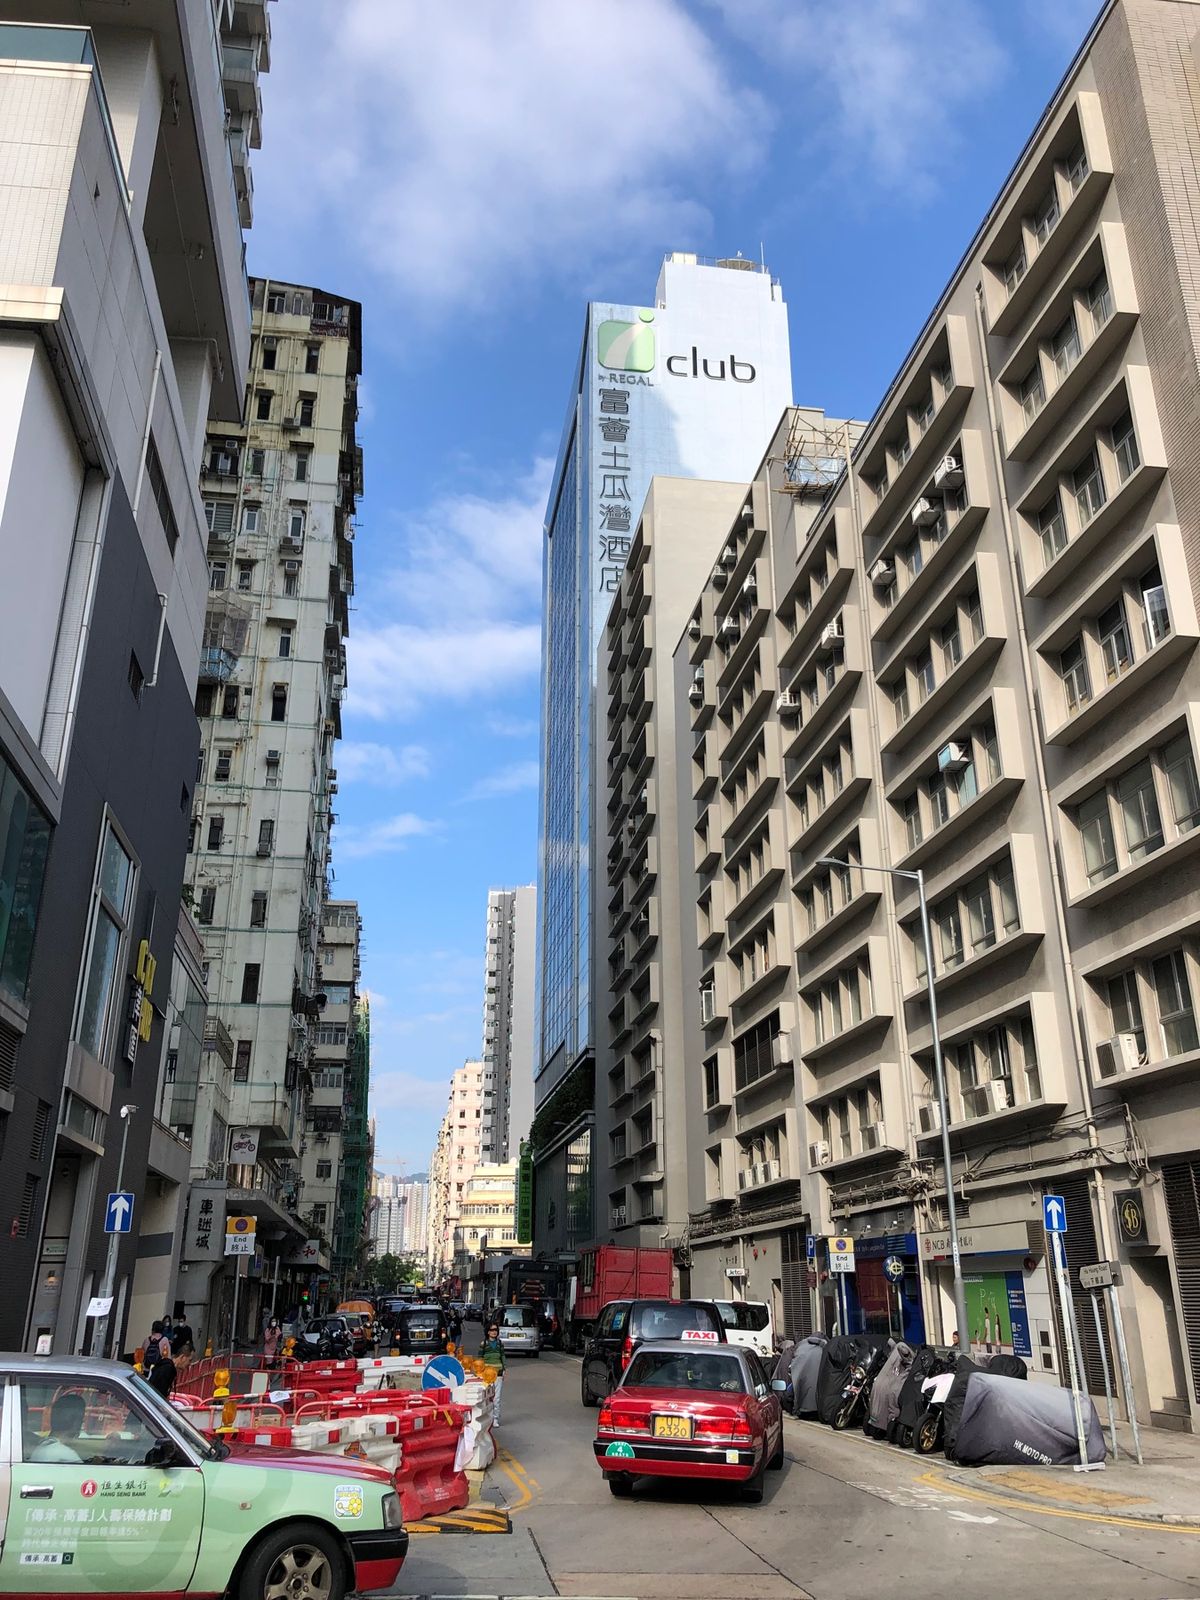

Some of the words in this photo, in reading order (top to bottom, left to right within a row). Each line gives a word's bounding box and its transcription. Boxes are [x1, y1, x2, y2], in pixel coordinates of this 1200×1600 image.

[666, 346, 757, 384] club
[609, 373, 654, 387] REGAL
[599, 387, 631, 593] 富薈土瓜灣酒店
[231, 1244, 249, 1252] 終止
[932, 1239, 945, 1251] NCB
[685, 1331, 715, 1340] TAXI
[667, 1416, 680, 1426] UJ
[659, 1425, 687, 1436] 2320
[1013, 1439, 1024, 1451] HK
[1022, 1444, 1040, 1460] MOTO
[1038, 1453, 1053, 1466] PRO
